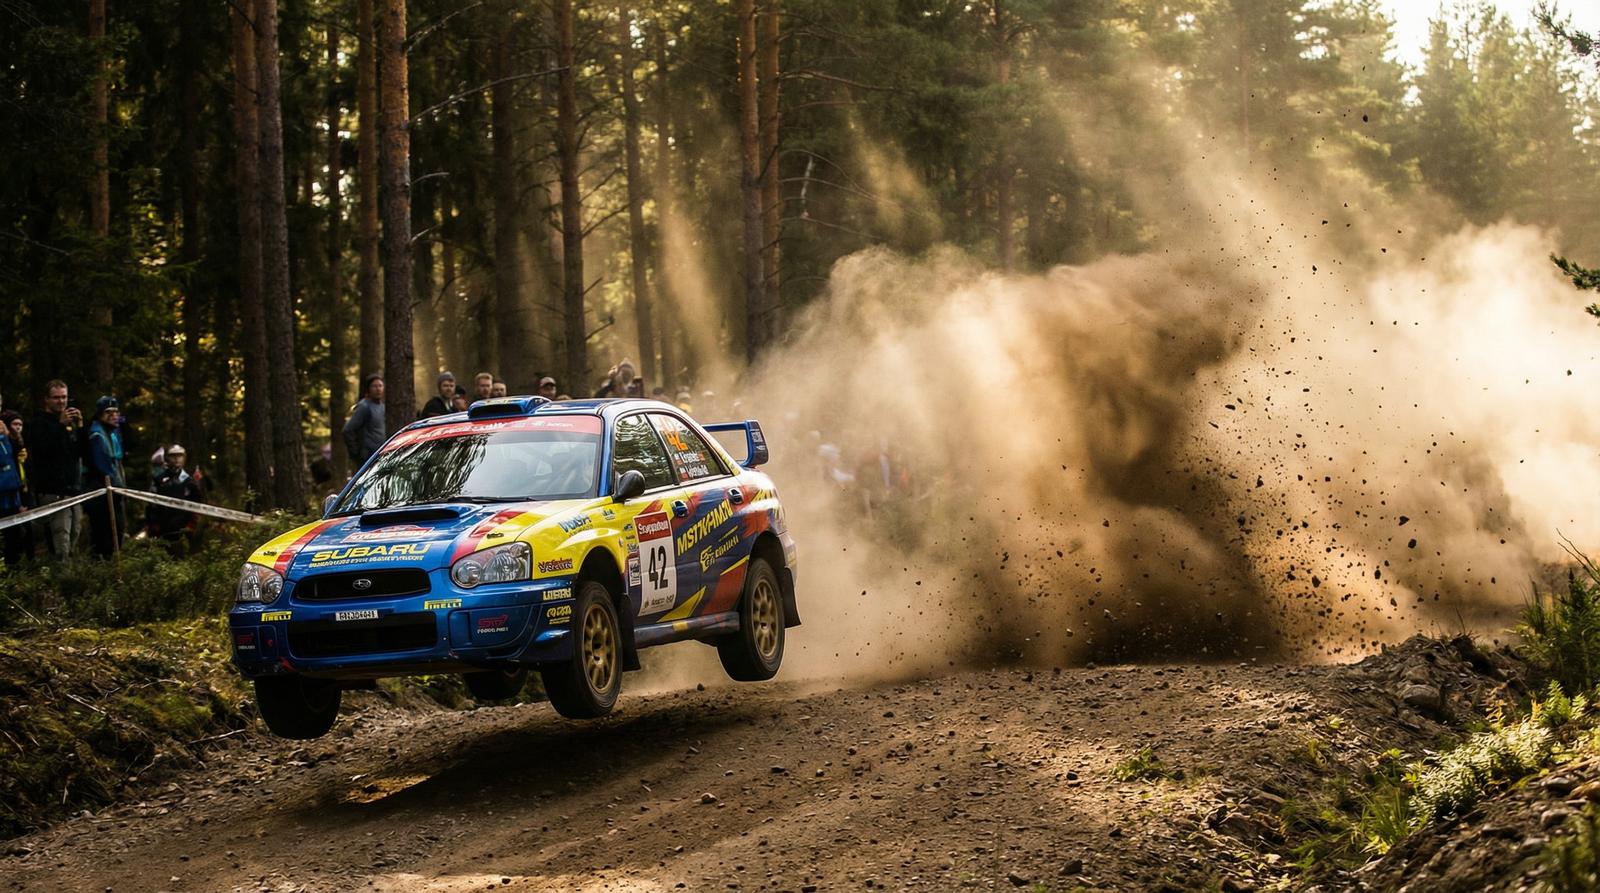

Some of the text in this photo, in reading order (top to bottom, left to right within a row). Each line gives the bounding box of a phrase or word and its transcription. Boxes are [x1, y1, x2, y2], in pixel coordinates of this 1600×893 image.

[312, 543, 432, 562] SUBARU
[649, 545, 669, 590] 42
[424, 599, 463, 610] PIRELLI
